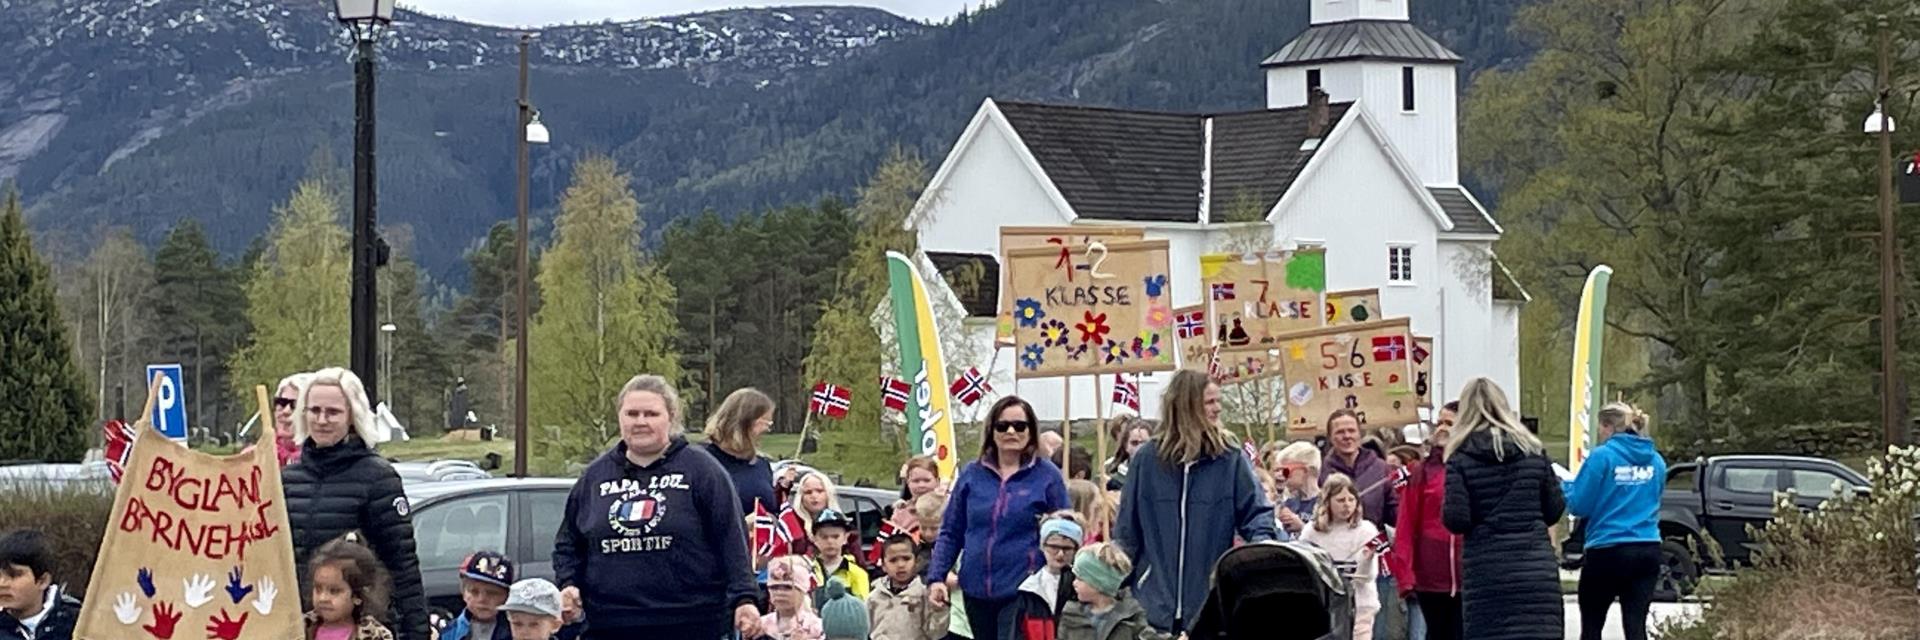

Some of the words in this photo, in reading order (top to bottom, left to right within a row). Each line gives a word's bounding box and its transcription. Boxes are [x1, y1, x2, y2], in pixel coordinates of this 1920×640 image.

[1056, 241, 1116, 282] 1-2
[1046, 285, 1132, 307] KLASSE
[1249, 279, 1269, 303] 7
[1244, 301, 1312, 319] KLASSE
[1320, 338, 1365, 369] 5-6
[158, 375, 175, 431] P
[600, 479, 640, 496] PAPA
[601, 535, 673, 554] SPORTIF
